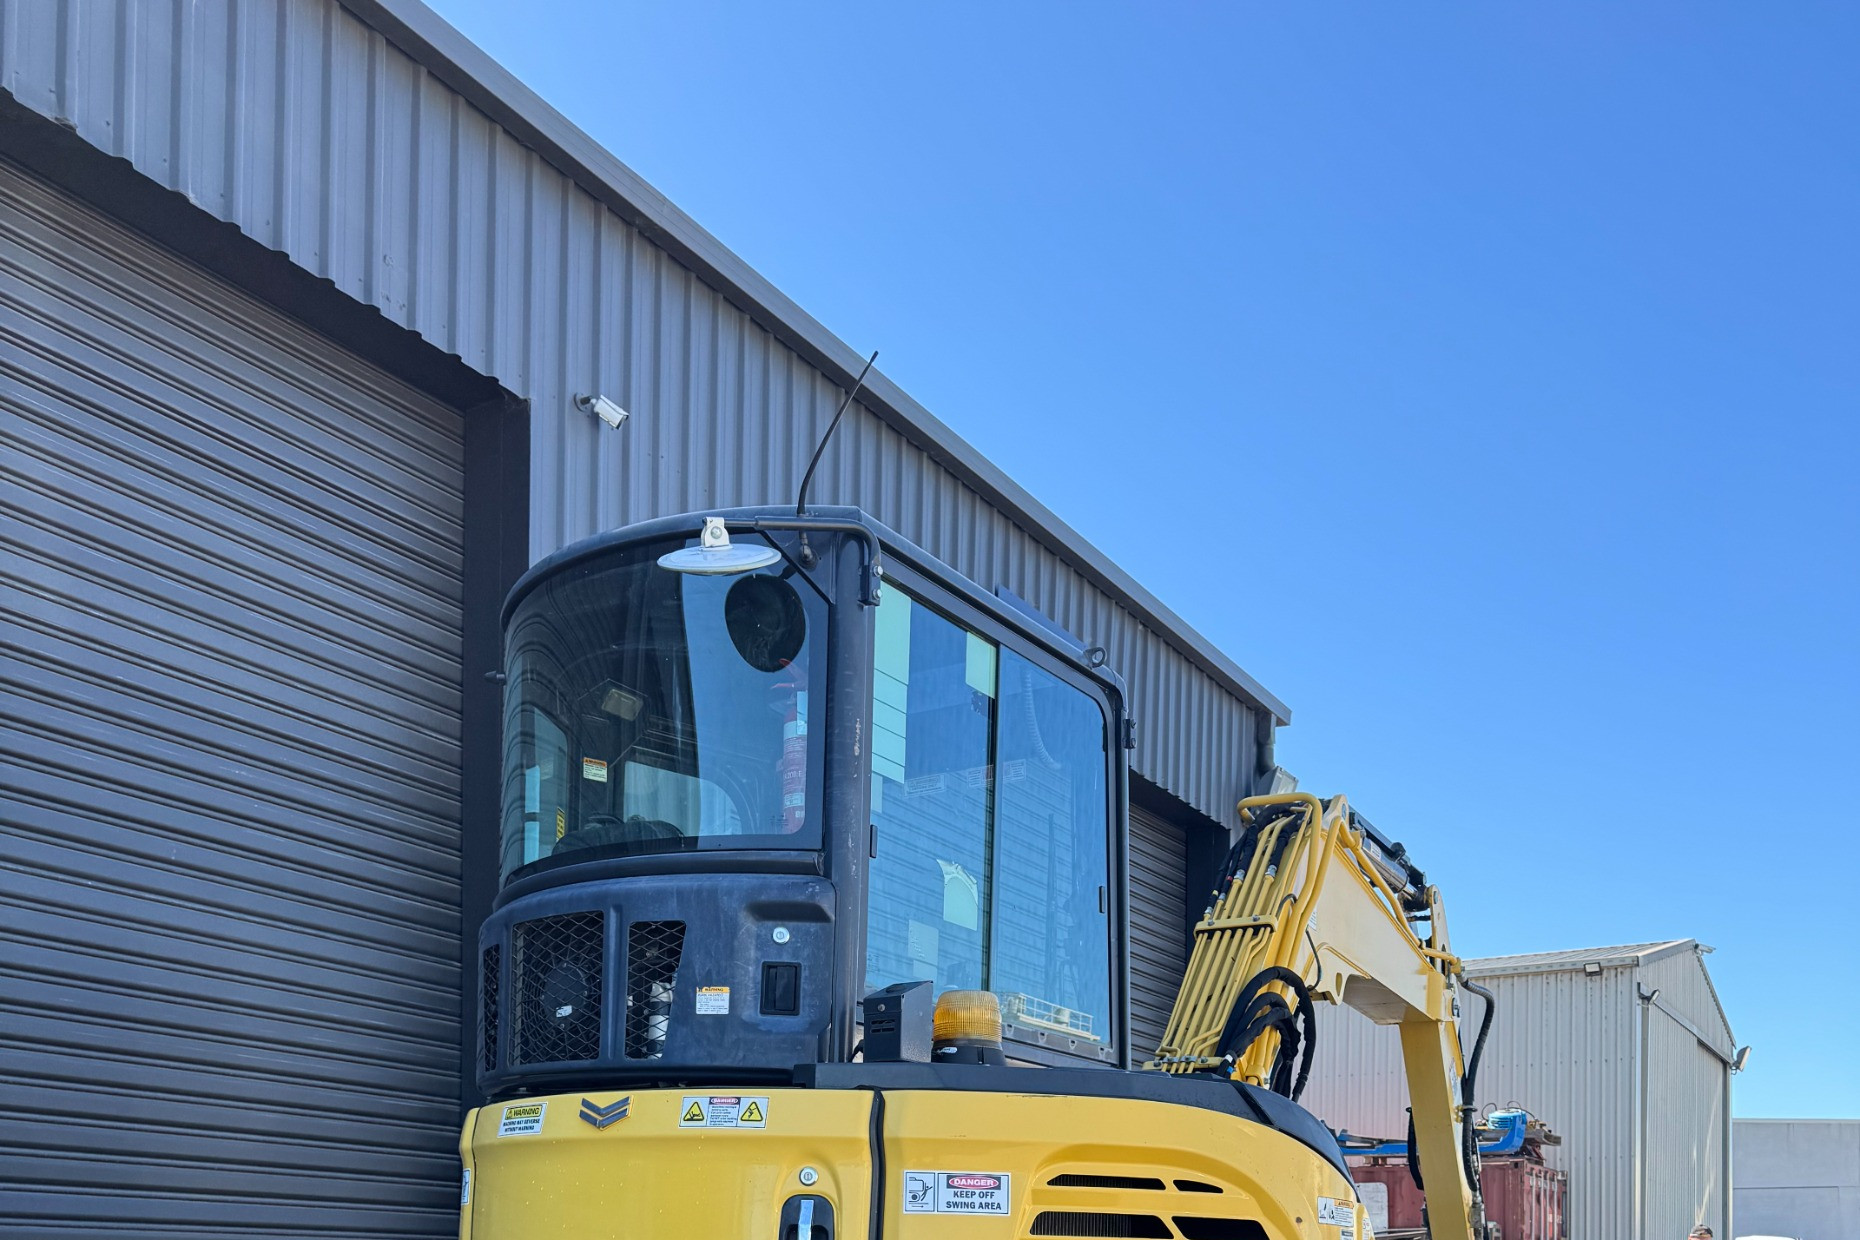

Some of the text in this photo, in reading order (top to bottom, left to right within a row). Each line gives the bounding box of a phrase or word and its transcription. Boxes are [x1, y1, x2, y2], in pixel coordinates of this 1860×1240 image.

[953, 1178, 994, 1186] DANGER
[953, 1190, 995, 1199] KEEP OFF
[946, 1200, 1002, 1211] SWING AREA
